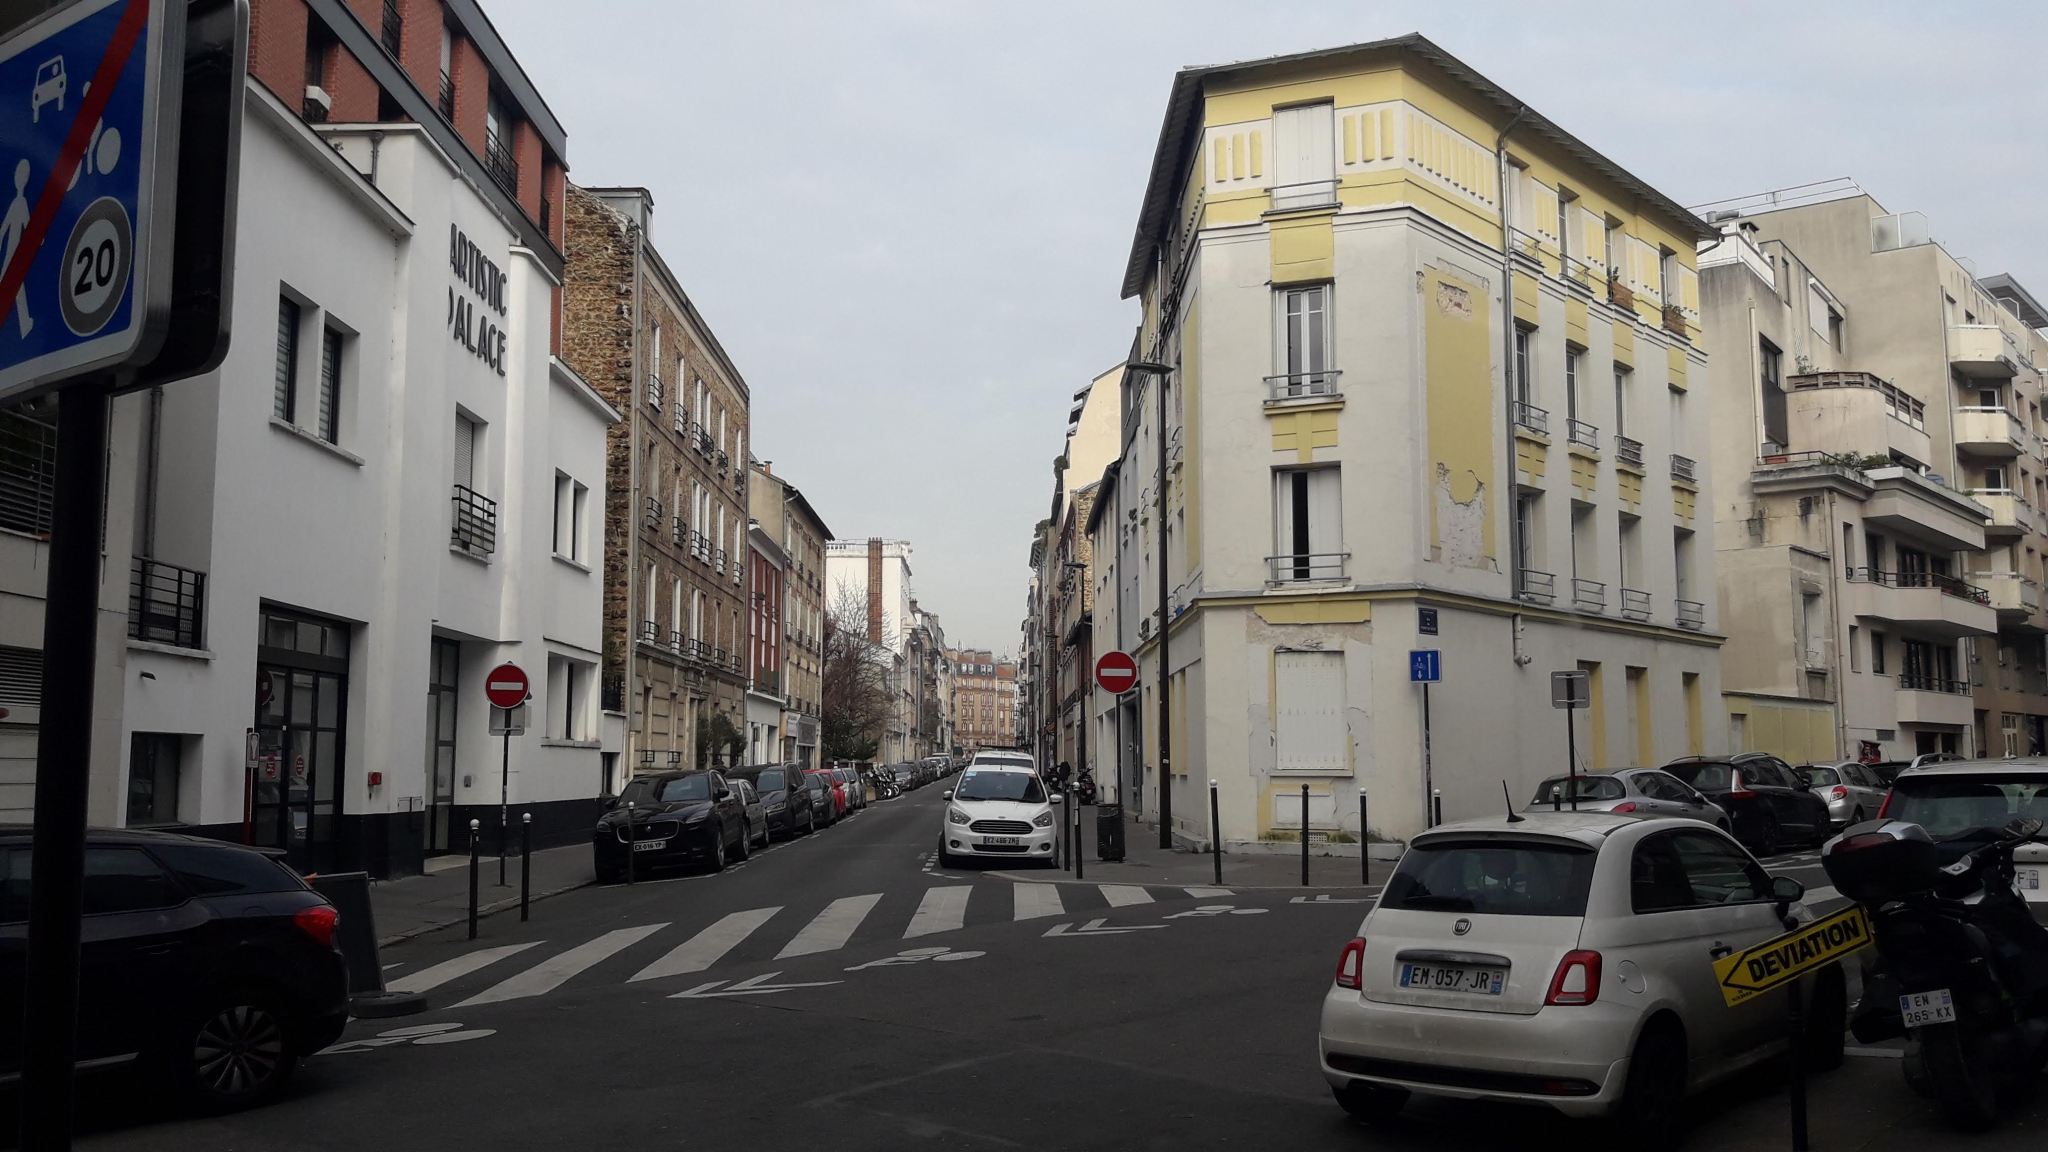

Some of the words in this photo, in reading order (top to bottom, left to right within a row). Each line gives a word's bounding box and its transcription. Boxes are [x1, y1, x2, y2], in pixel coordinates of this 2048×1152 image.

[74, 239, 115, 296] 20
[449, 222, 507, 317] ARTISTIC
[1747, 916, 1860, 982] DEVIATION
